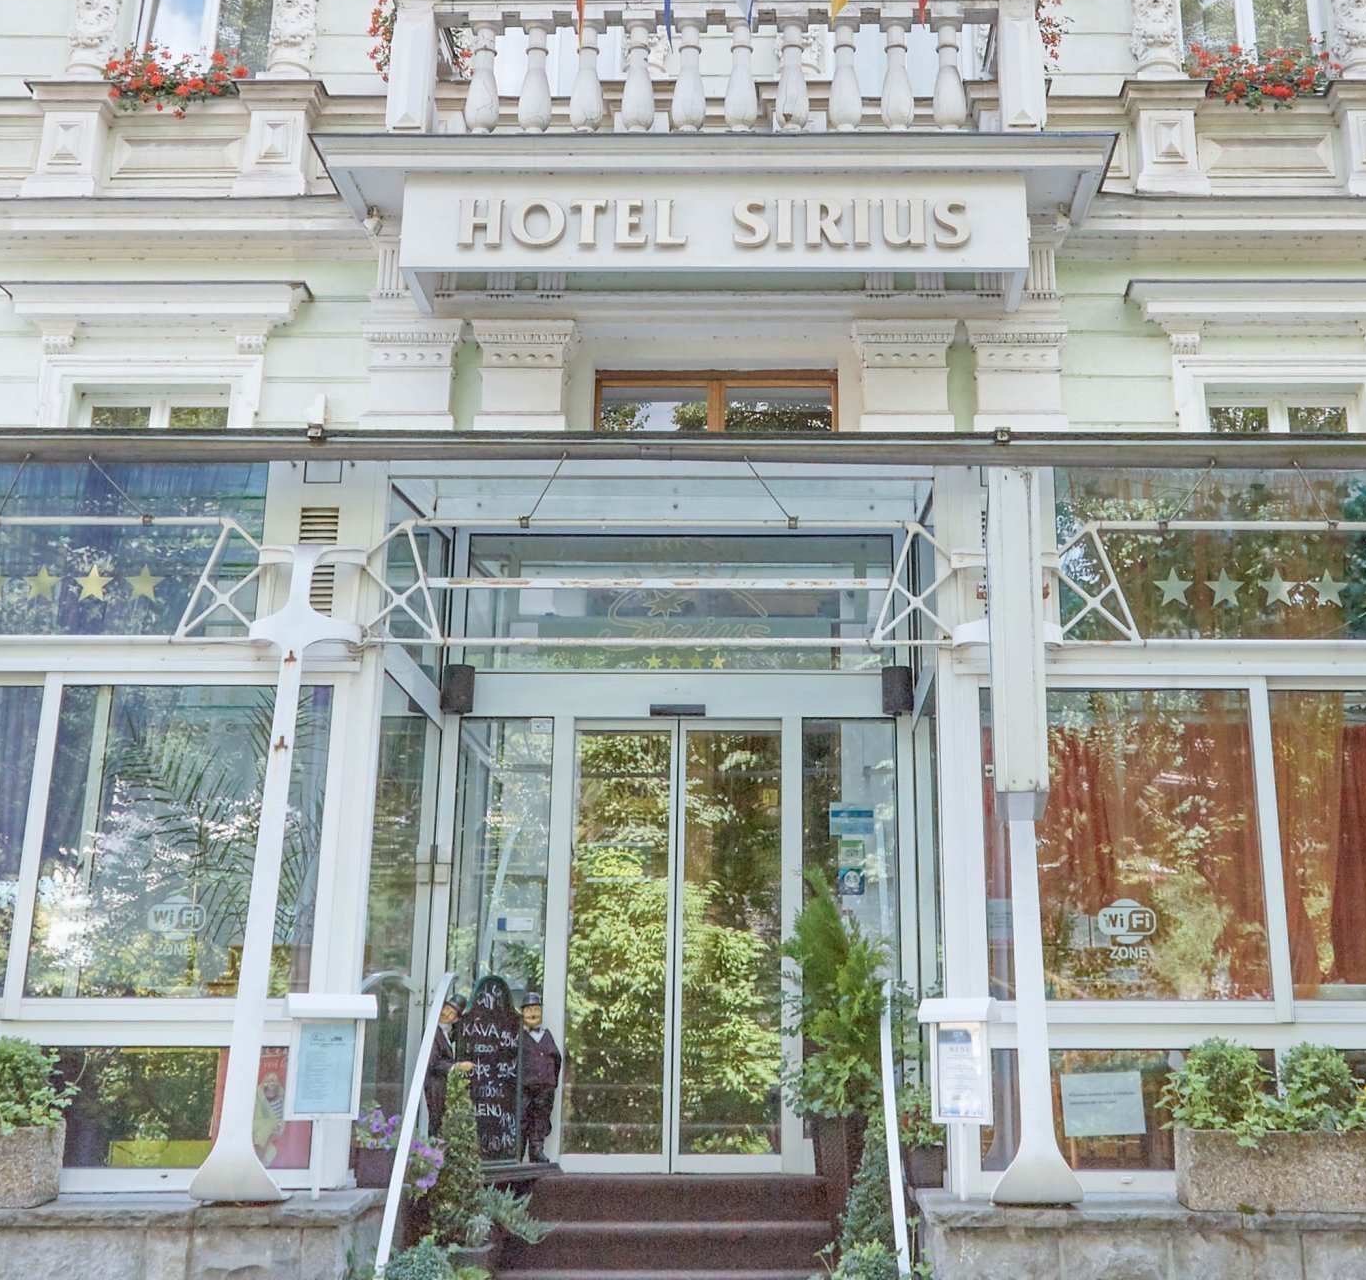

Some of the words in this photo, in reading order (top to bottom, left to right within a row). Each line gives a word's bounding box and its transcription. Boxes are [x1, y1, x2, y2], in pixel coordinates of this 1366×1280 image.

[456, 198, 689, 248] HOTEL
[732, 198, 973, 248] SIRIUS
[154, 943, 192, 956] ZONE
[1110, 947, 1148, 960] ZONE
[462, 1018, 500, 1039] KÁVA
